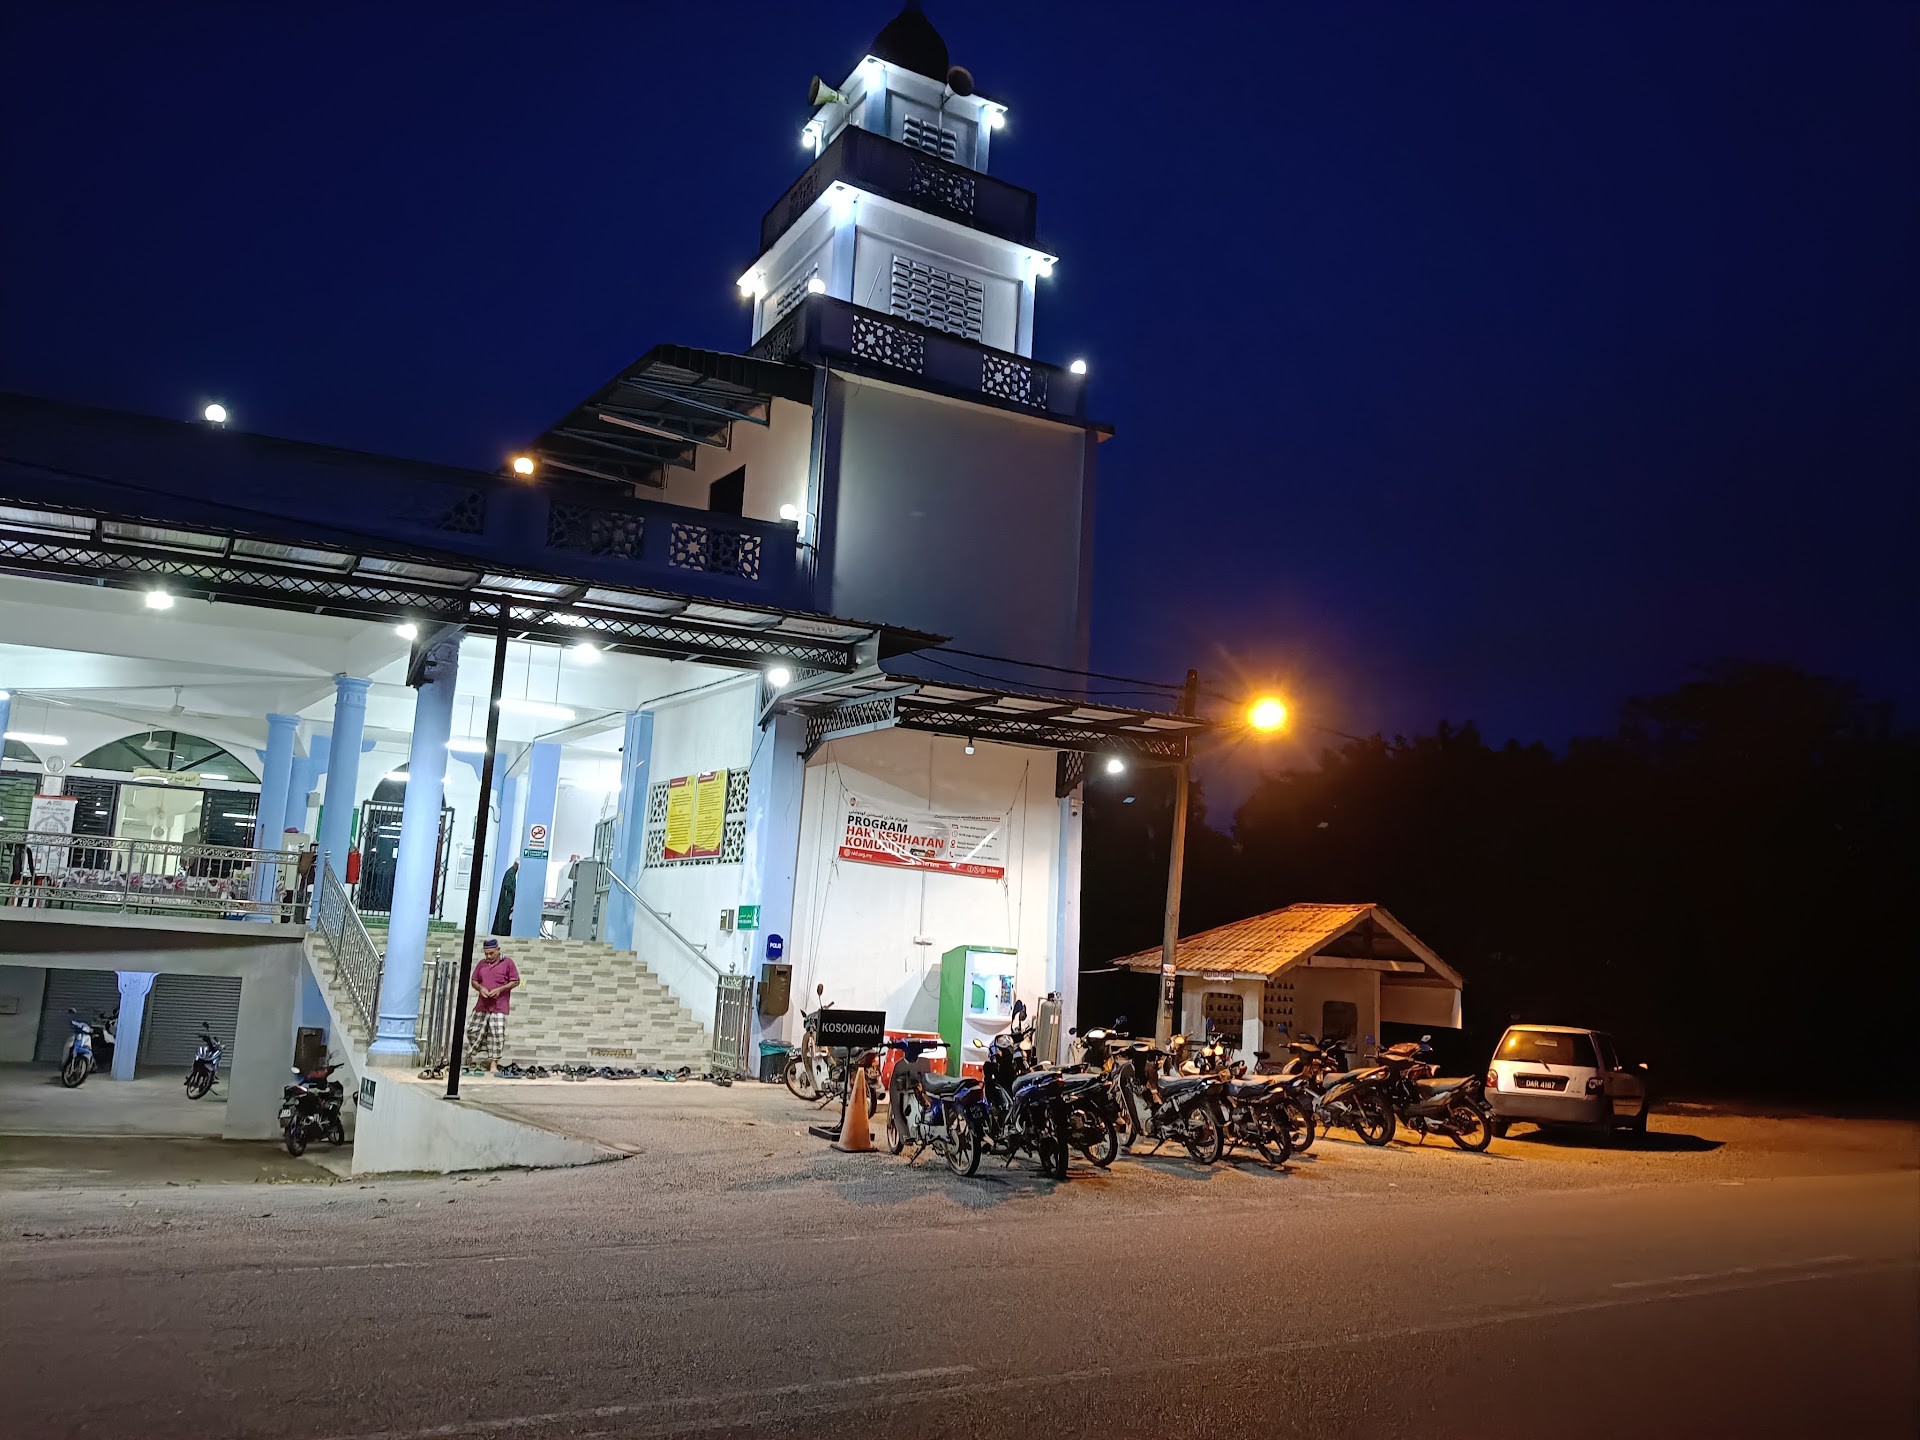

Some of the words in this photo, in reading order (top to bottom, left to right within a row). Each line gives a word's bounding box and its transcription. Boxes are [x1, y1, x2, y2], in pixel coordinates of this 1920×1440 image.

[847, 815, 908, 833] PROGRAM
[878, 830, 945, 849] KESIHATAN
[822, 1022, 880, 1035] KOSONGKAN
[1526, 1080, 1539, 1088] DAR
